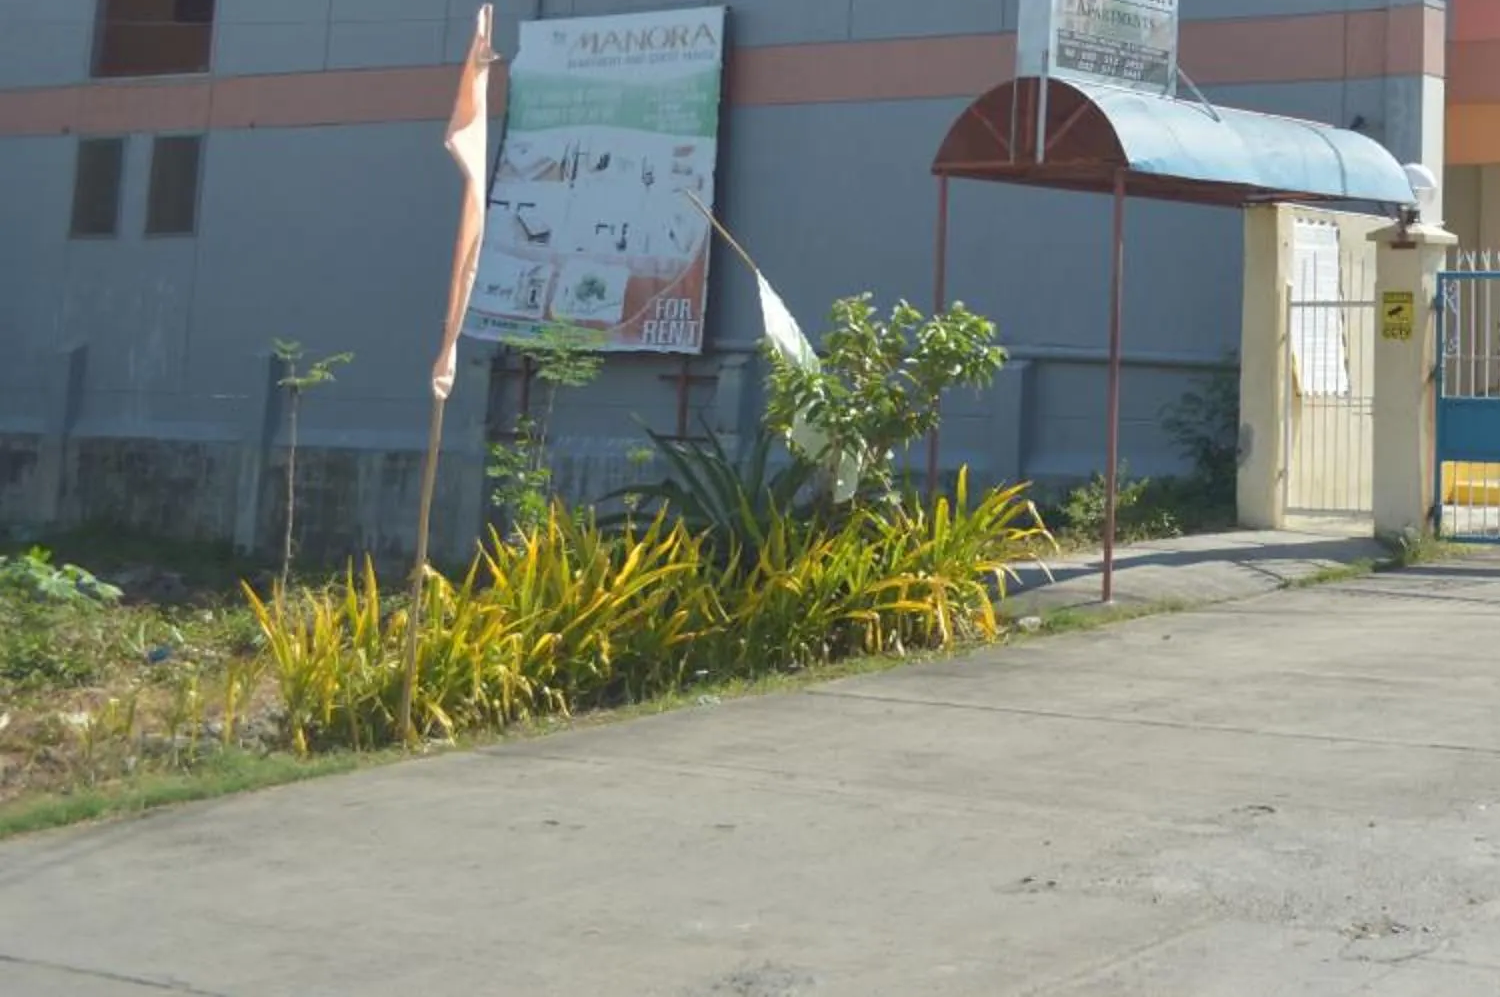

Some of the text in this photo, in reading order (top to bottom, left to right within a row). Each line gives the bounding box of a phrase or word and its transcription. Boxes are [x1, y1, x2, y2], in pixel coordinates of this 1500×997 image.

[567, 22, 717, 56] MANORA
[655, 297, 694, 321] FOR
[641, 320, 699, 346] RENT
